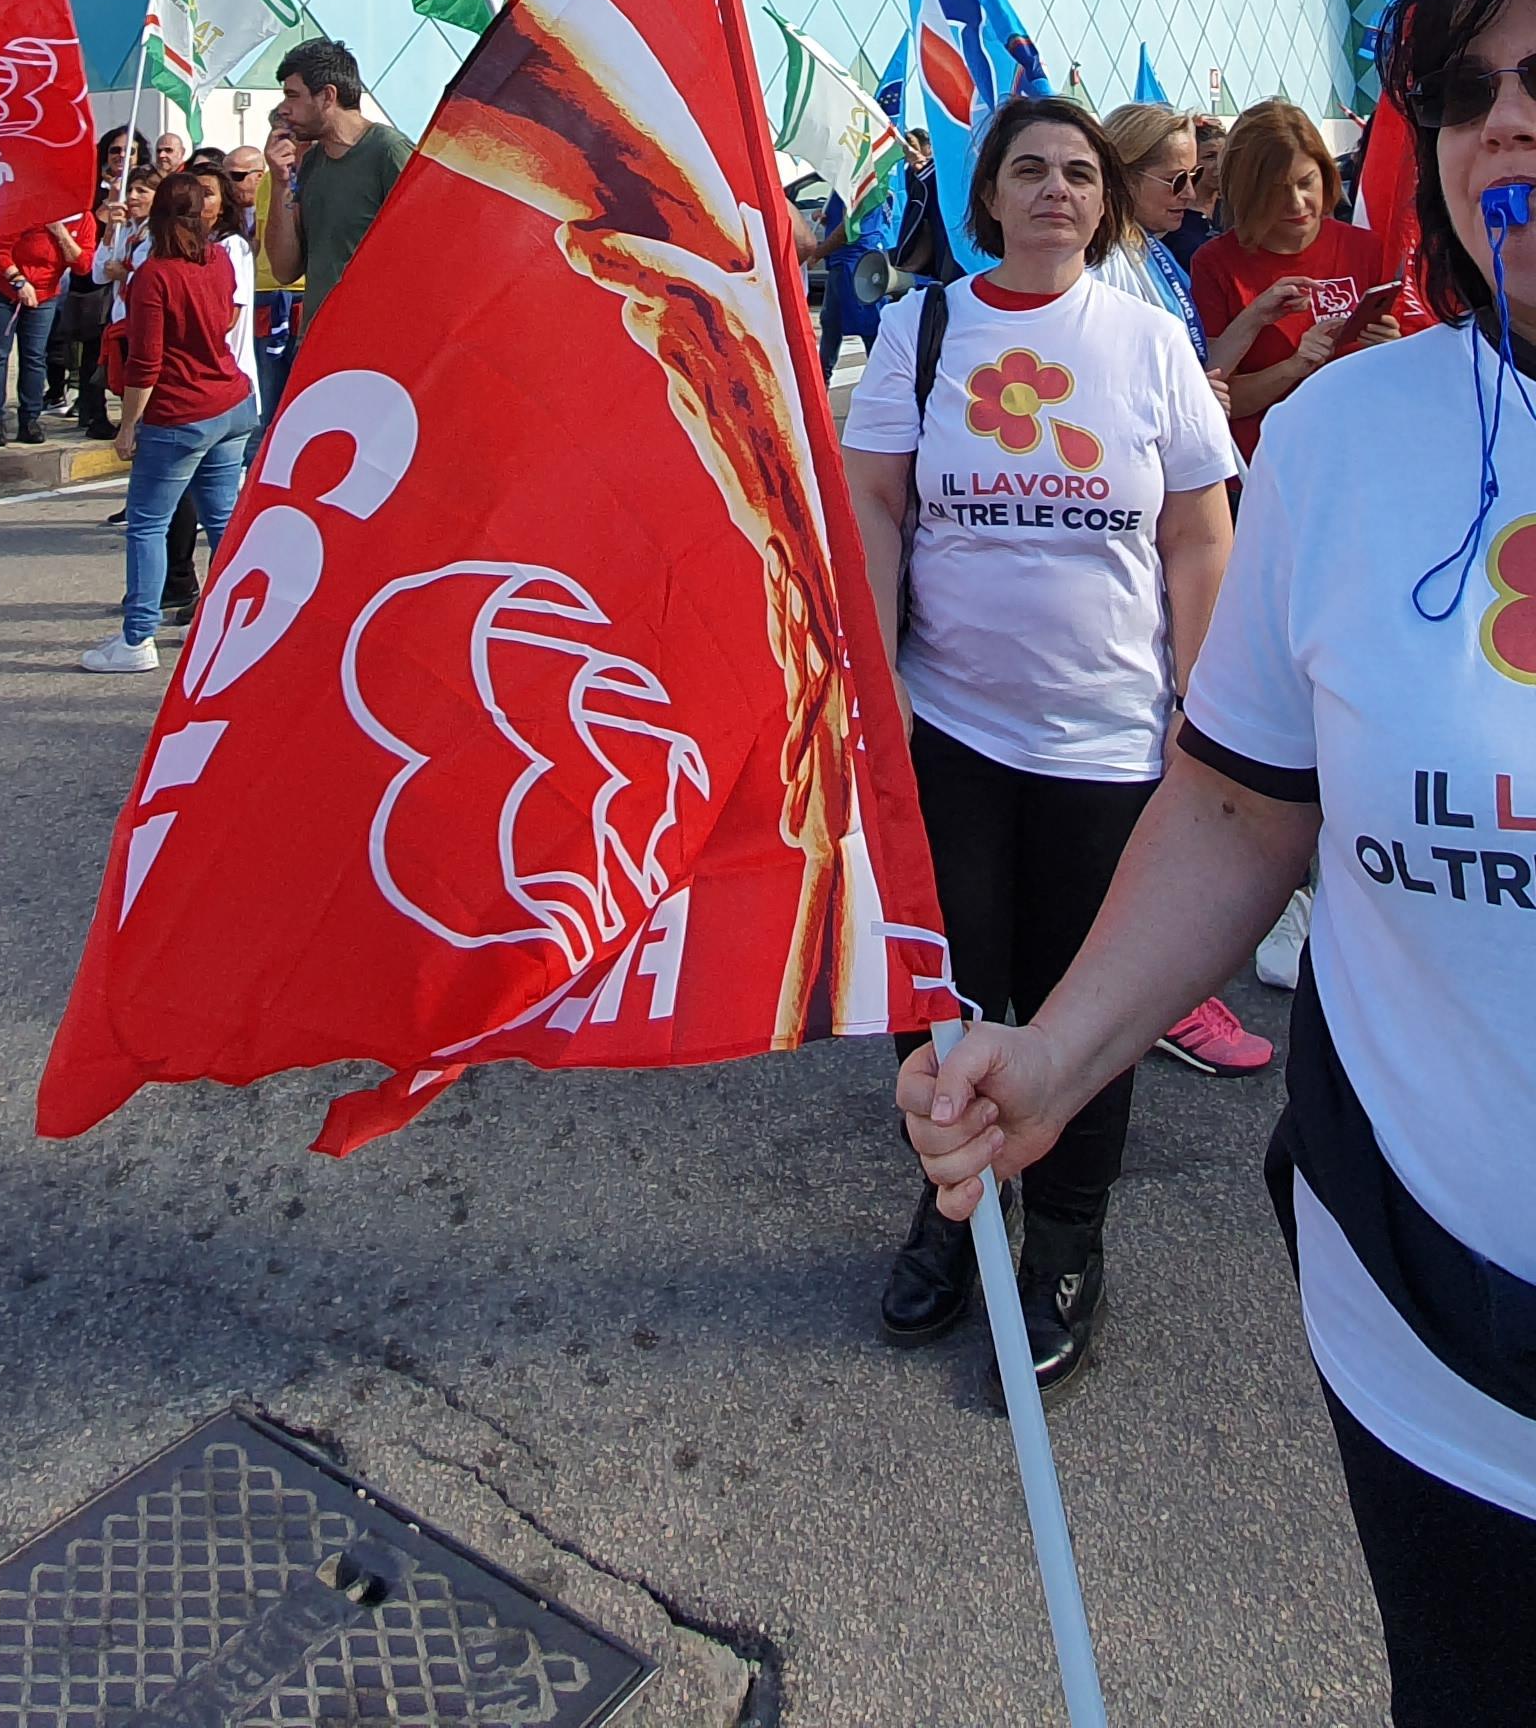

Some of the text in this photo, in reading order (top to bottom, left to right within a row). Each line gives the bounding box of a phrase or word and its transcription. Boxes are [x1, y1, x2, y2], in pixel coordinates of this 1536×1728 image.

[942, 472, 1111, 501] IL LAVORO
[1015, 504, 1055, 528] LE
[1061, 506, 1143, 532] COSE
[1414, 770, 1475, 830] IL
